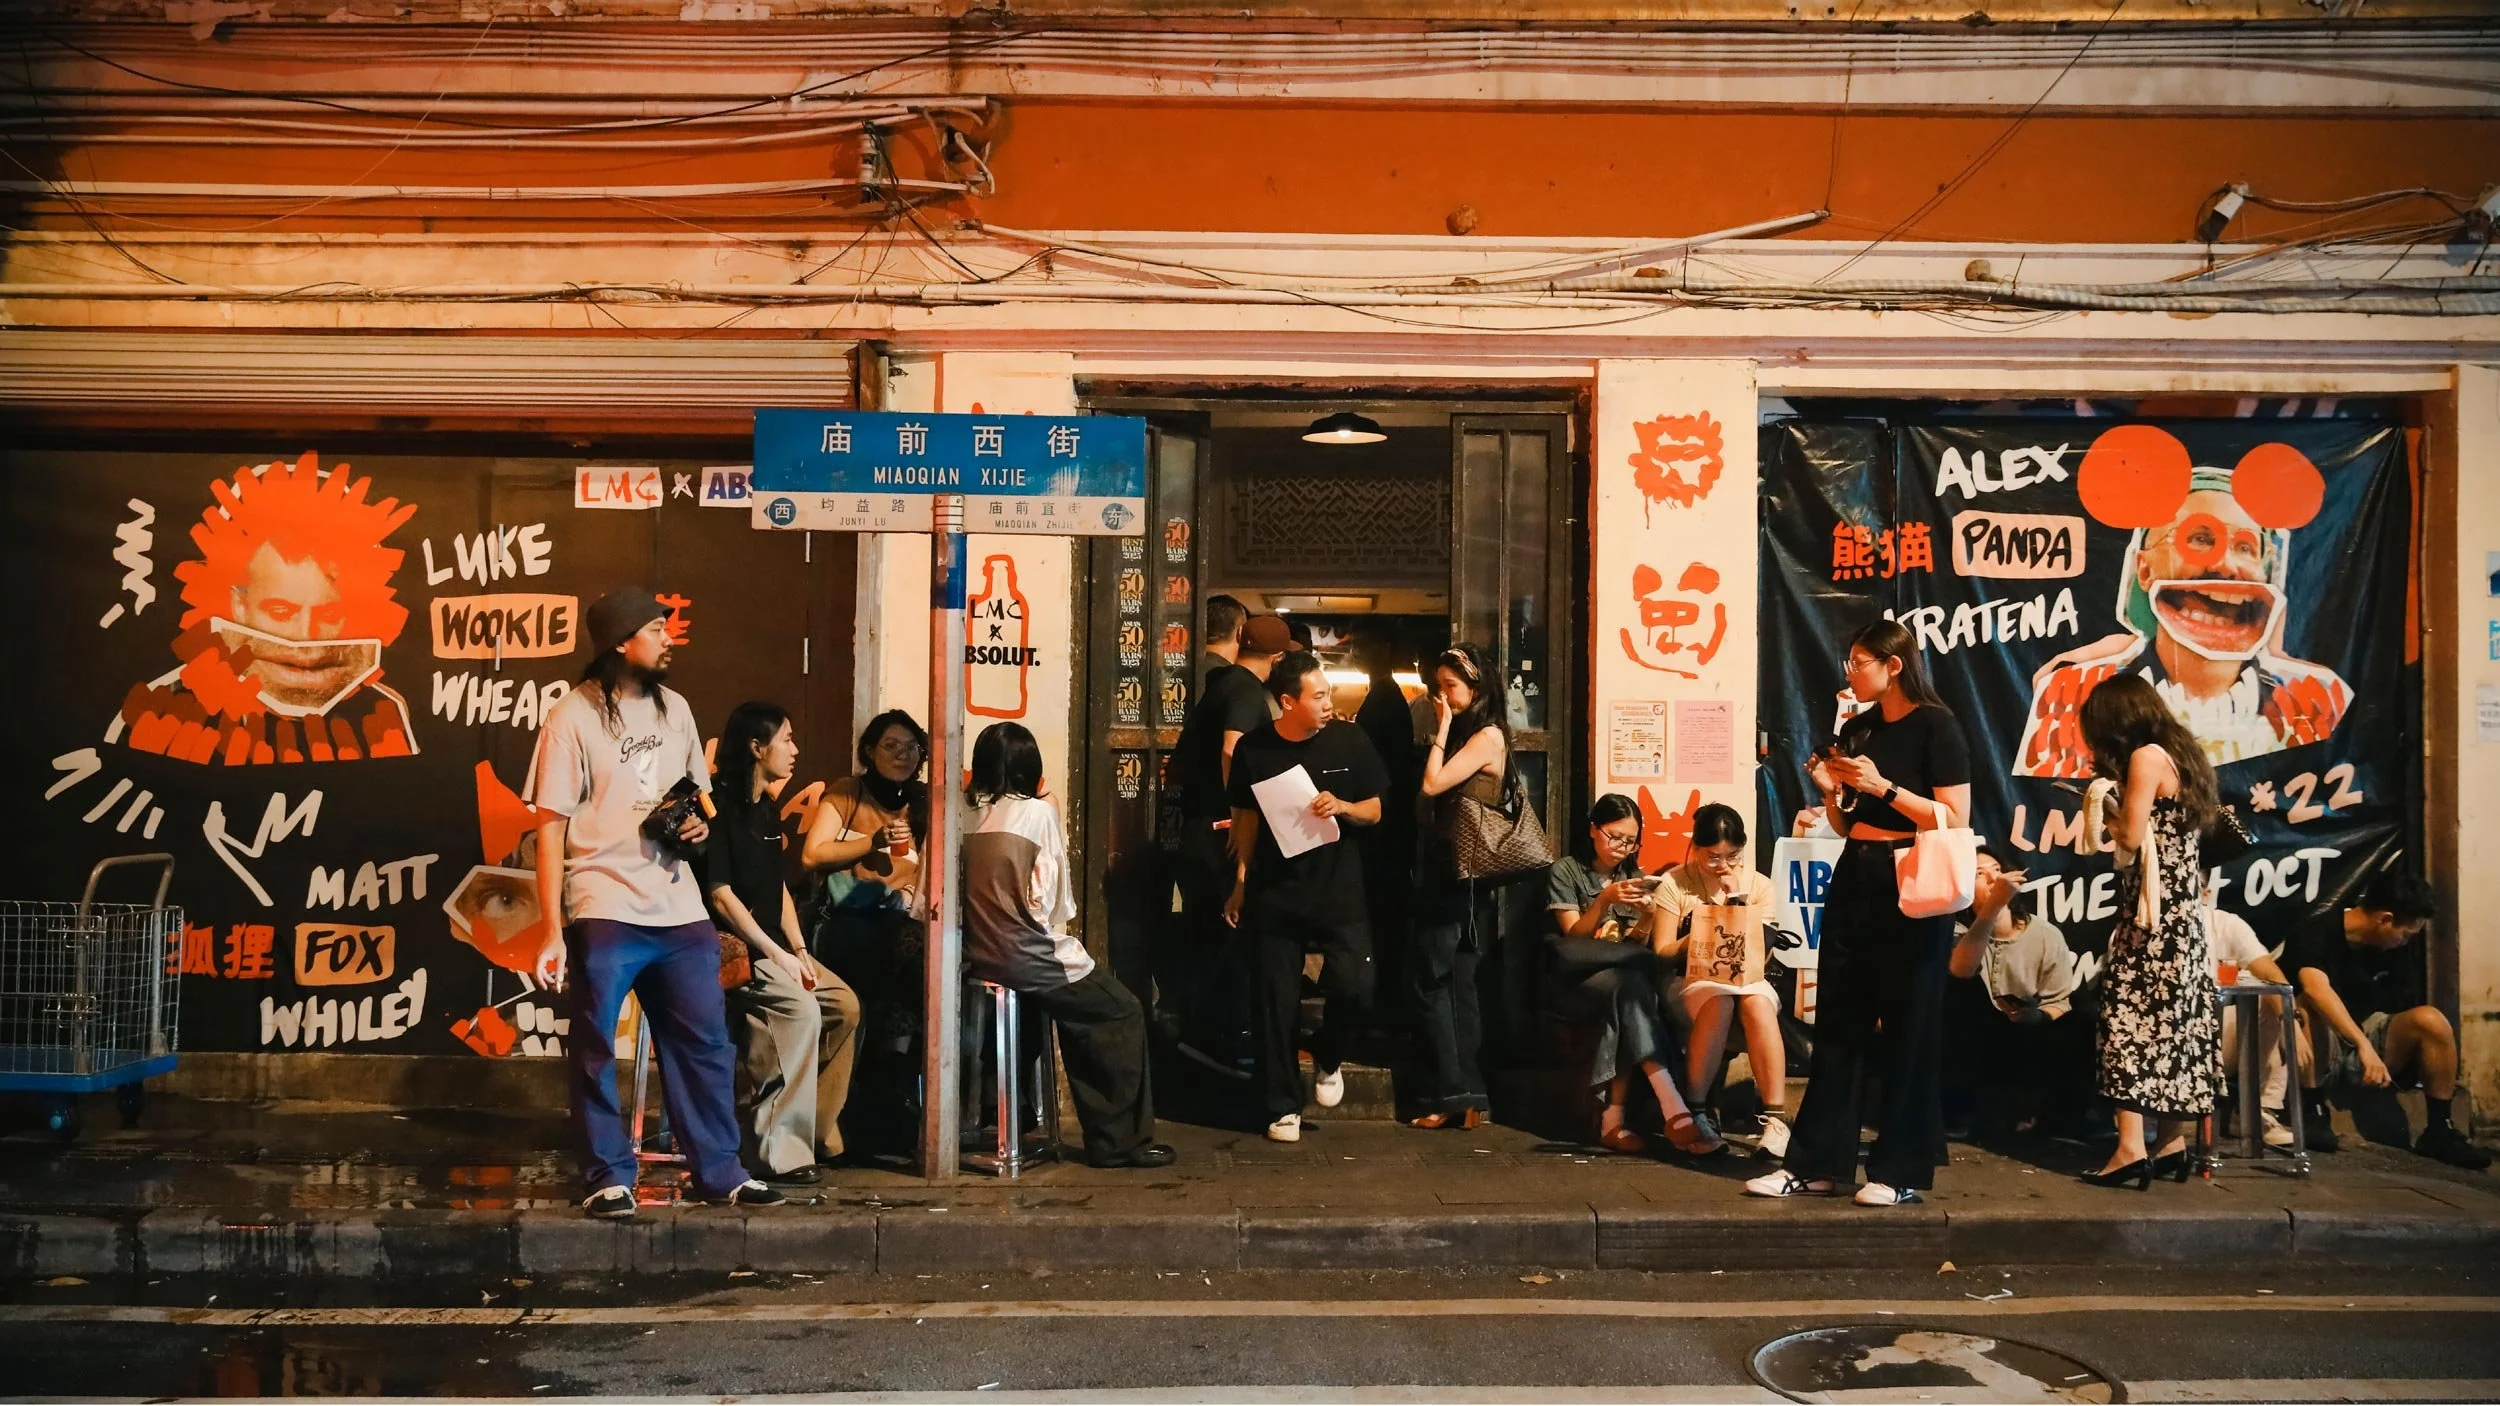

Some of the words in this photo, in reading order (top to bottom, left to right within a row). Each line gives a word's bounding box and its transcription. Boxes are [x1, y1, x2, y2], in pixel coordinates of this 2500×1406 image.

[821, 422, 1080, 458] 庙前西街
[874, 467, 960, 486] MIAOQIAN
[980, 468, 1026, 486] XIJIE
[1935, 443, 2070, 499] ALEX
[581, 471, 658, 503] LMC
[707, 472, 754, 500] AB
[775, 503, 791, 519] 西
[821, 498, 905, 513] 均益路
[840, 517, 866, 526] JUNYI
[875, 517, 886, 526] LU
[995, 520, 1037, 529] MIAOQIAN
[1165, 522, 1190, 542] 50
[422, 523, 552, 586] LUKE
[1832, 520, 1934, 581] 熊猫
[1962, 518, 2072, 571] PANDA
[1119, 573, 1145, 593] 50
[1165, 576, 1190, 596] 50
[970, 599, 1023, 620] LMC
[441, 603, 568, 650] WOOKIE
[1119, 626, 1145, 646] 50
[1163, 627, 1189, 646] 50
[963, 645, 1041, 667] BSOLUT.
[1116, 682, 1142, 701] 50
[1162, 683, 1187, 702] 50
[1117, 758, 1141, 778] 50
[2010, 804, 2116, 855] LM
[306, 853, 439, 911] MATT
[1789, 860, 1832, 904] AB
[2019, 872, 2118, 923] TUE
[2245, 847, 2341, 906] OCT
[166, 921, 275, 978] 狐狸
[304, 930, 386, 976] FOX
